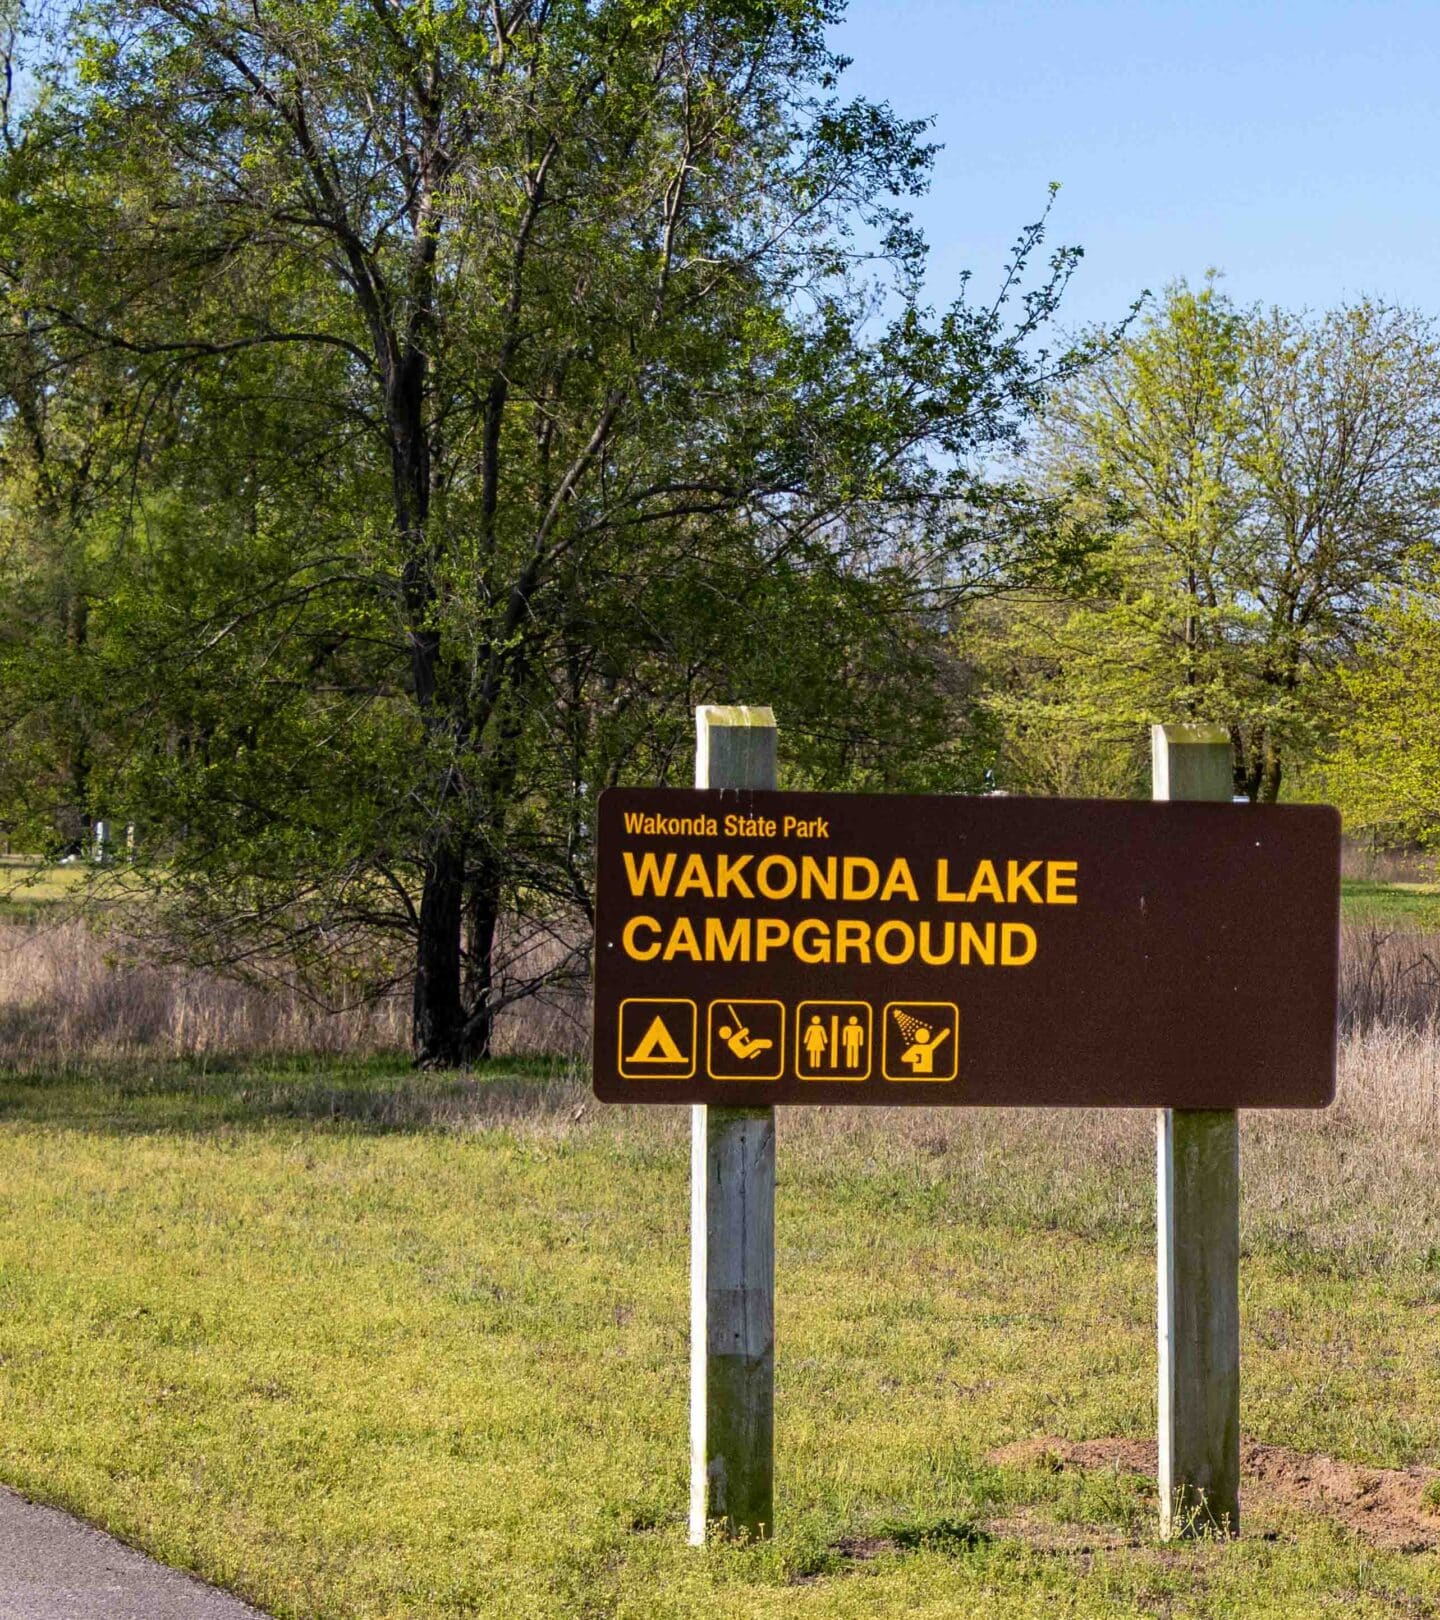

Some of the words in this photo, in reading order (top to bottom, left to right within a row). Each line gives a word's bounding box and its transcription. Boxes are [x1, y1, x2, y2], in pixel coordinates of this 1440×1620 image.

[623, 812, 717, 836] Wakonda
[724, 814, 777, 838] State
[783, 815, 829, 839] Park
[622, 851, 919, 902] WAKONDA
[936, 858, 1079, 905] LAKE
[621, 915, 1038, 967] CAMPGROUND
